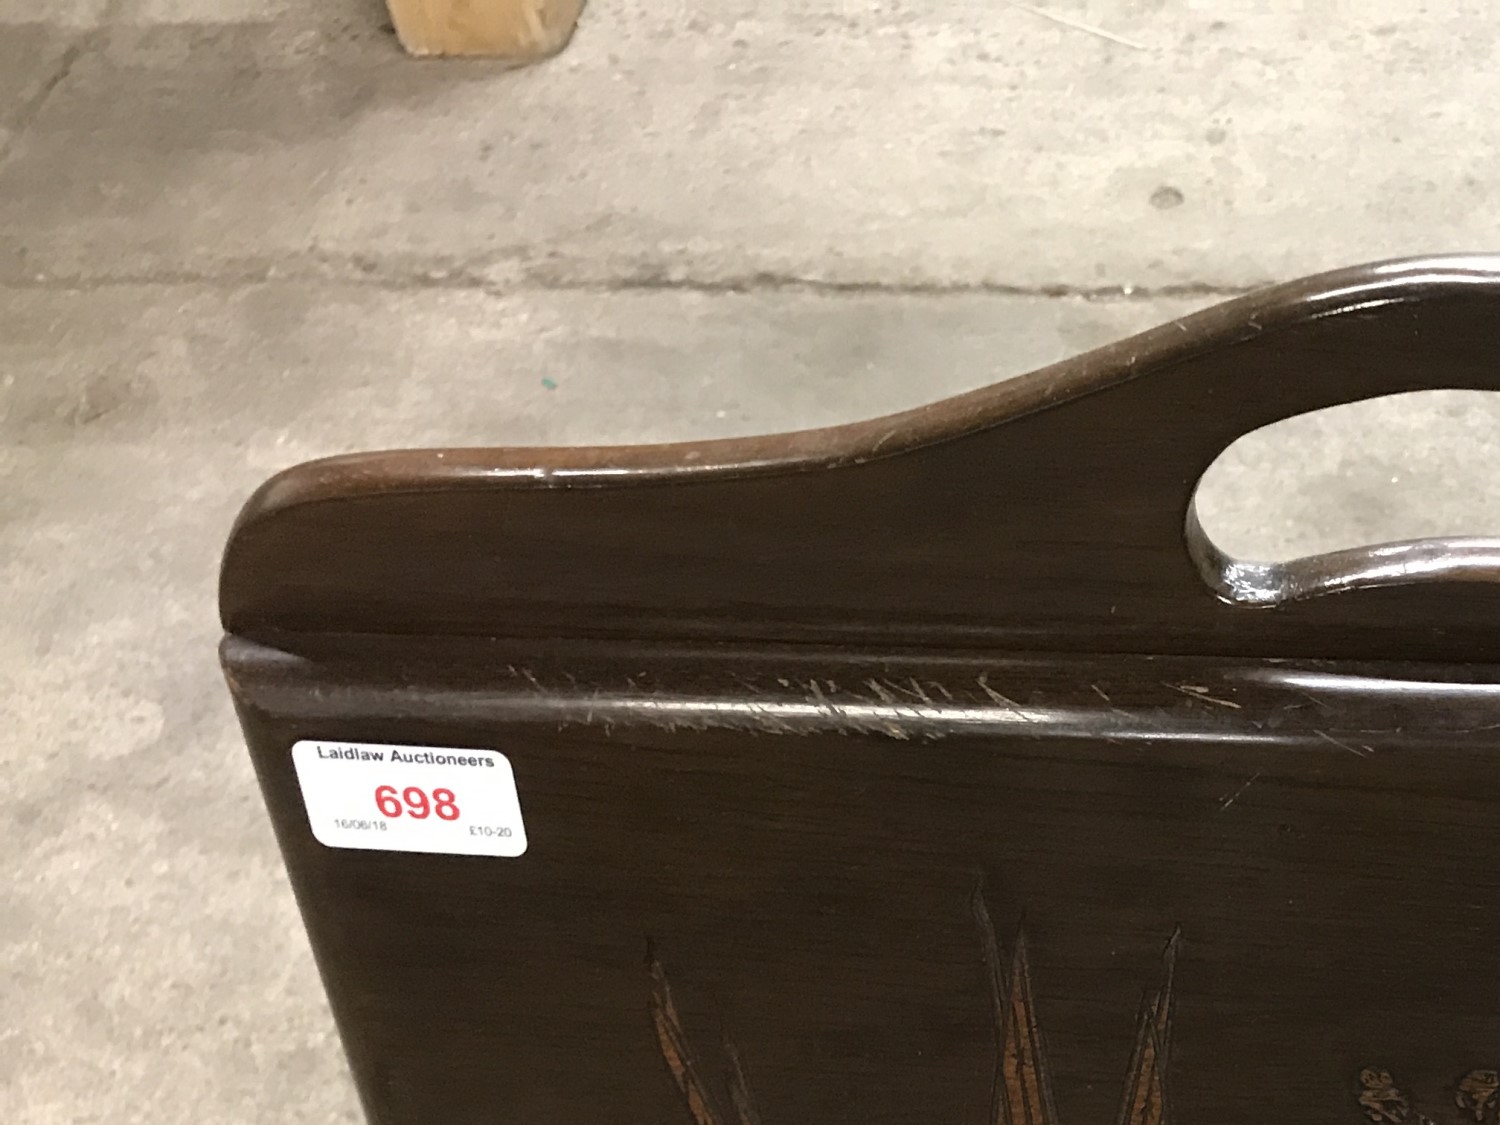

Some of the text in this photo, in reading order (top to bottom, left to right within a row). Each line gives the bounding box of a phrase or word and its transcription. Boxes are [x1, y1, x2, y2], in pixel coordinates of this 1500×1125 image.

[317, 746, 495, 768] Laidlaw Auctioneers
[375, 785, 460, 821] 698
[469, 825, 512, 838] £10-20
